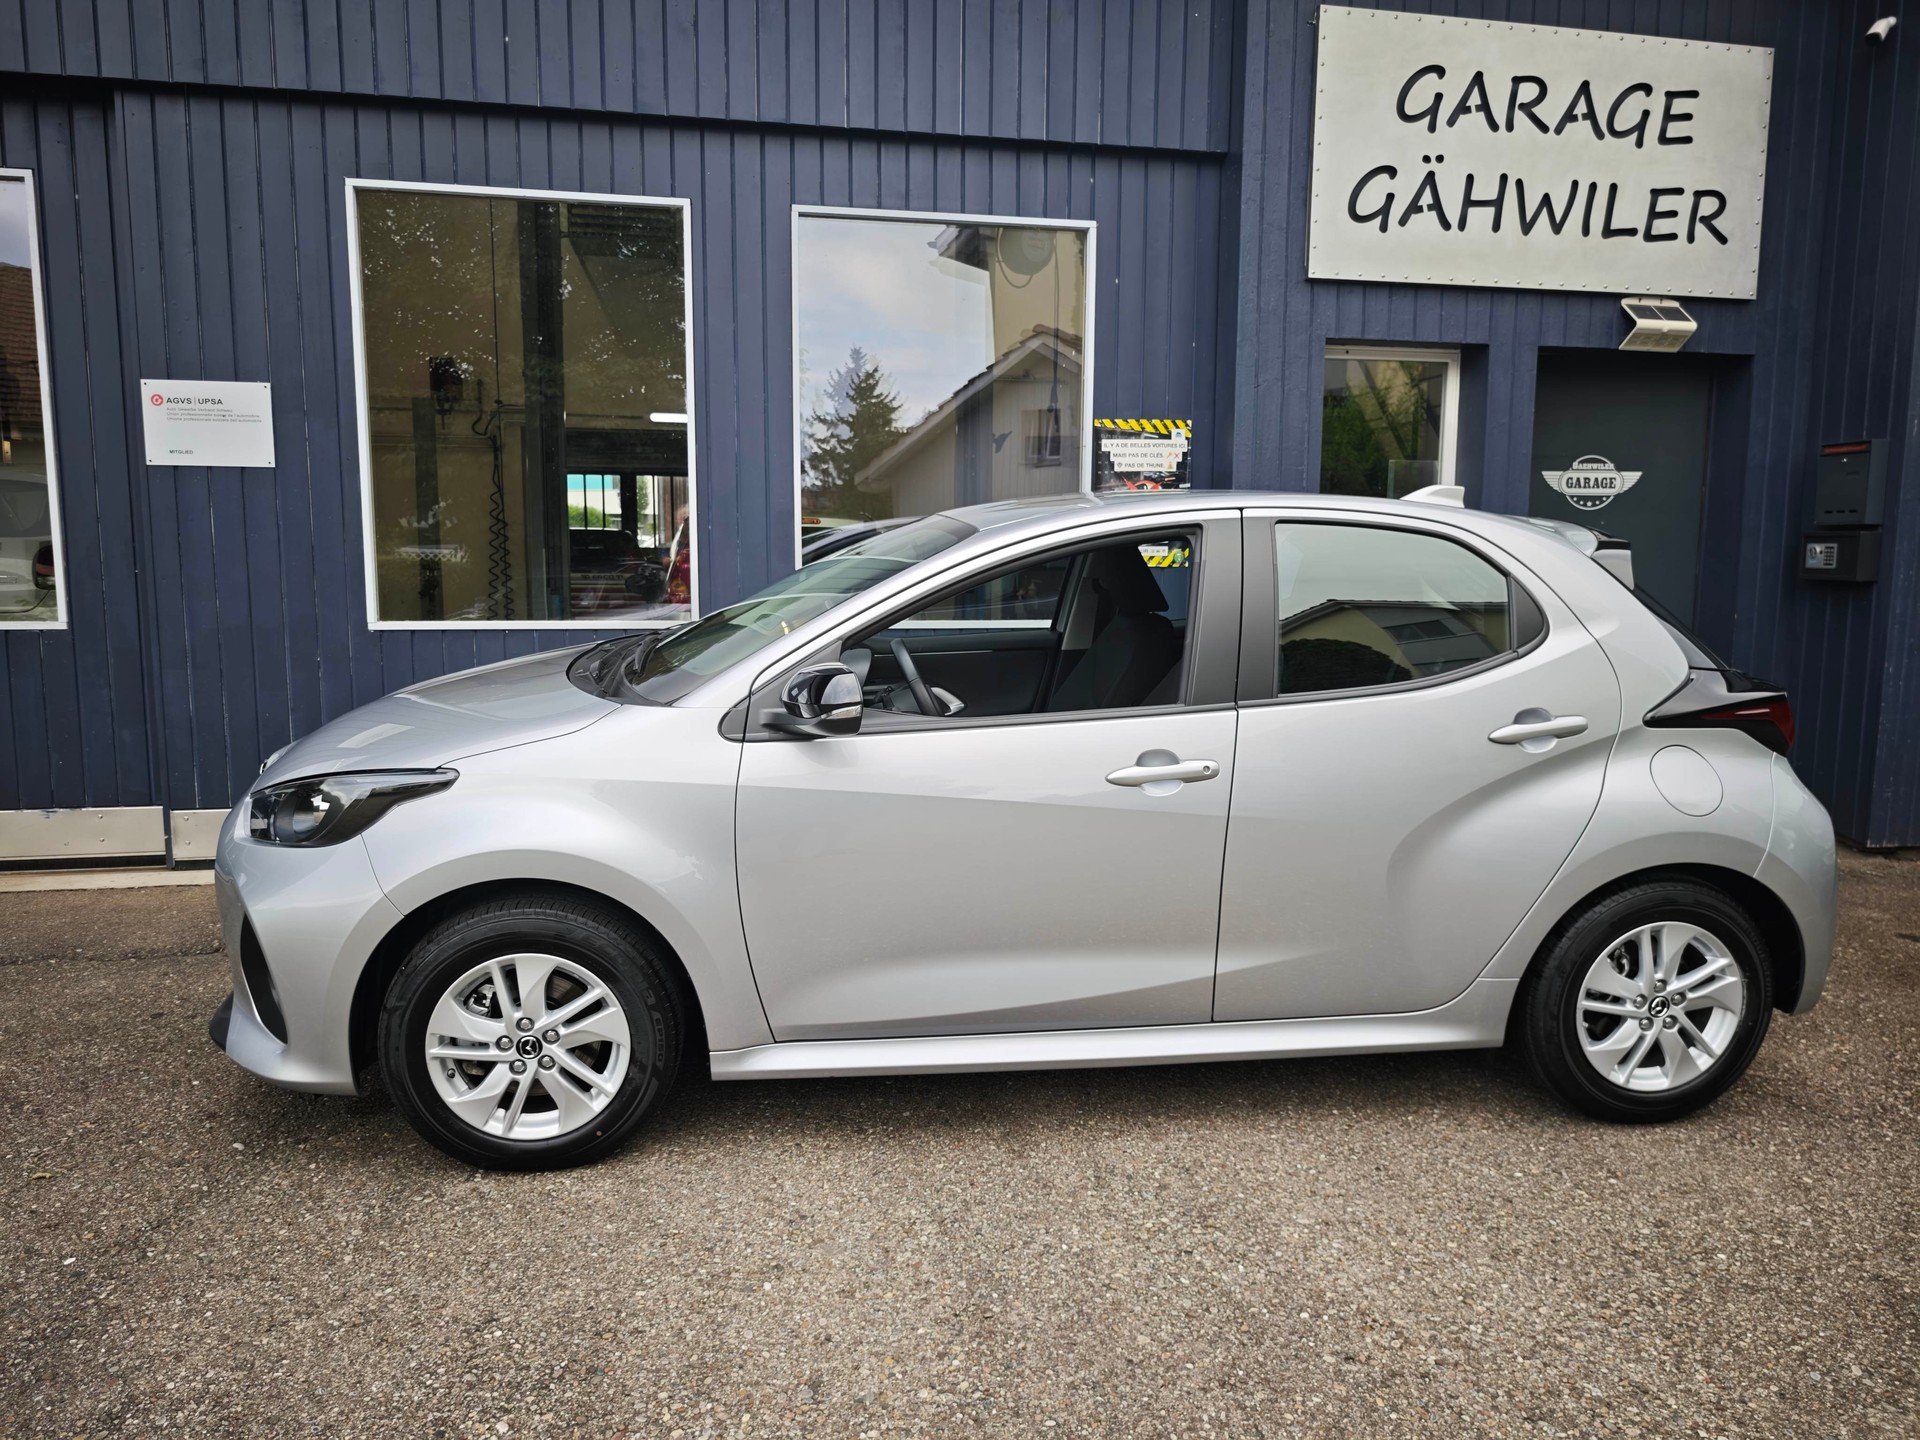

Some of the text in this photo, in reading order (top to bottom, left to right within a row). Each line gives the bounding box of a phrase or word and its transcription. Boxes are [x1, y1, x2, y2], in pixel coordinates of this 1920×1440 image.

[1395, 64, 1700, 149] GARAGE
[1347, 154, 1728, 245] GÄHWILER
[166, 397, 192, 405] AGVS
[1566, 477, 1617, 489] GARAGE
